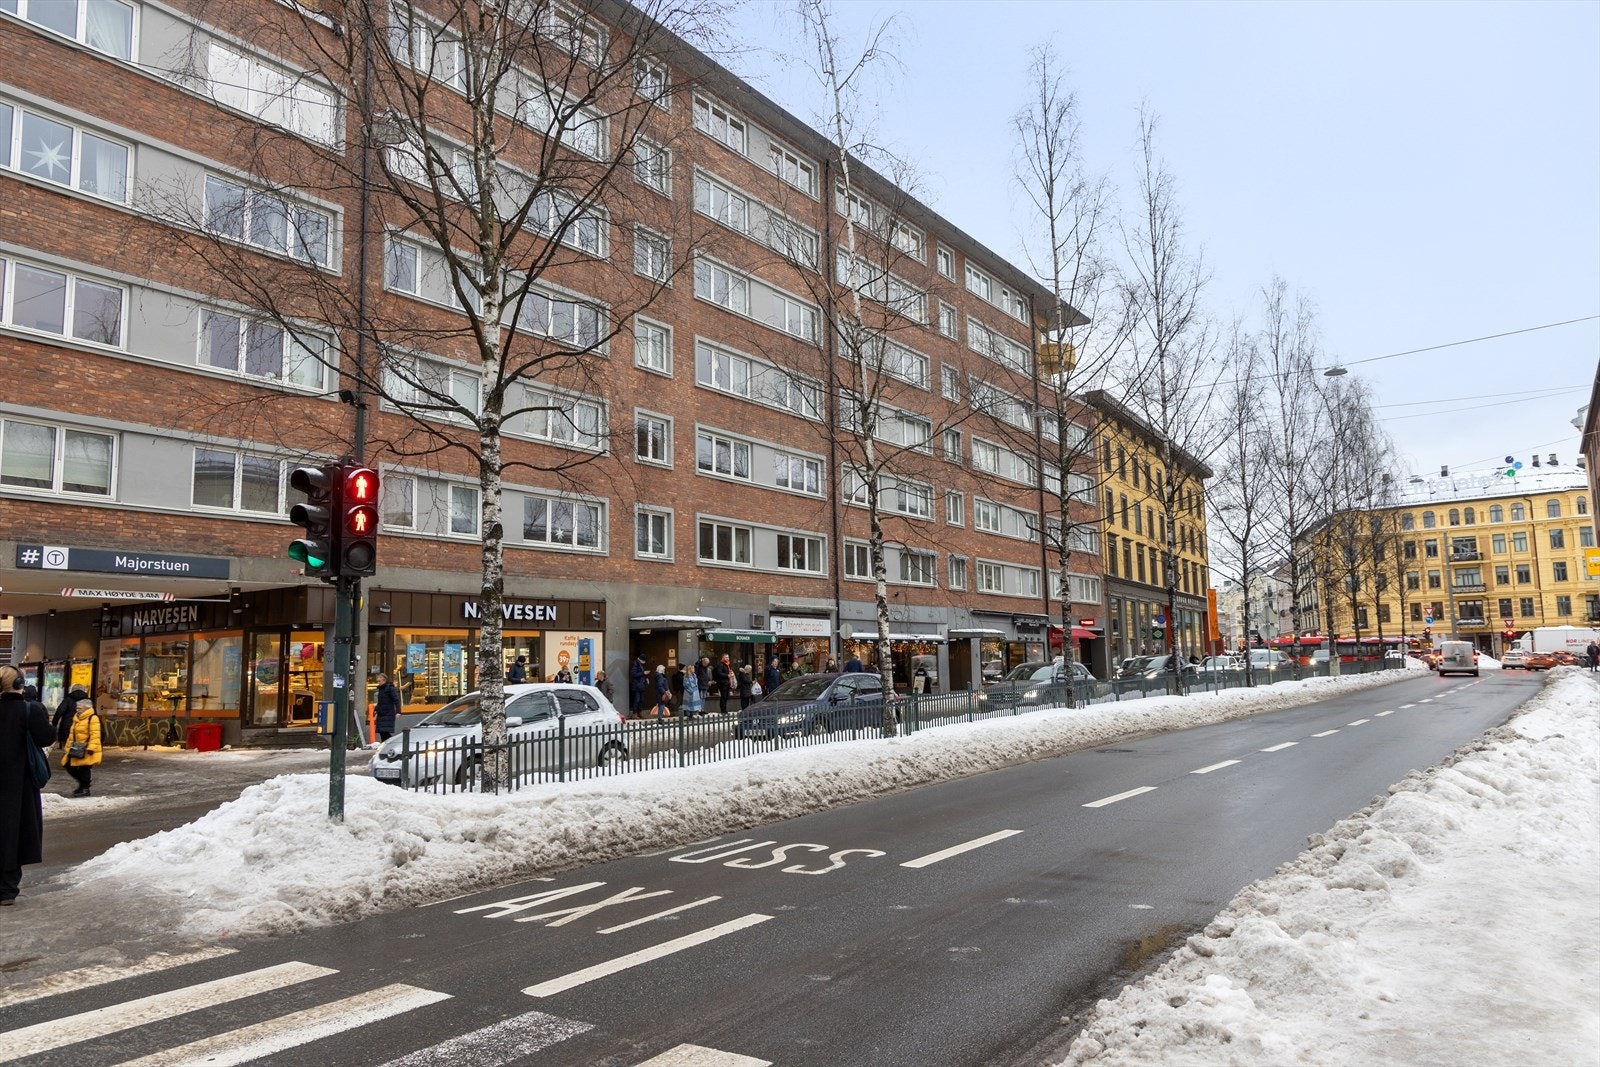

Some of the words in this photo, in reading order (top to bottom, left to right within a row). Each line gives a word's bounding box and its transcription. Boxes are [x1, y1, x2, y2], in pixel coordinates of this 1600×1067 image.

[115, 555, 190, 571] Majorstuen
[77, 589, 103, 597] MAX
[104, 590, 137, 598] HØYDE
[133, 605, 198, 627] NARVESEN
[464, 602, 557, 620] NVESEN
[640, 837, 887, 875] USS
[452, 880, 724, 934] AXI
